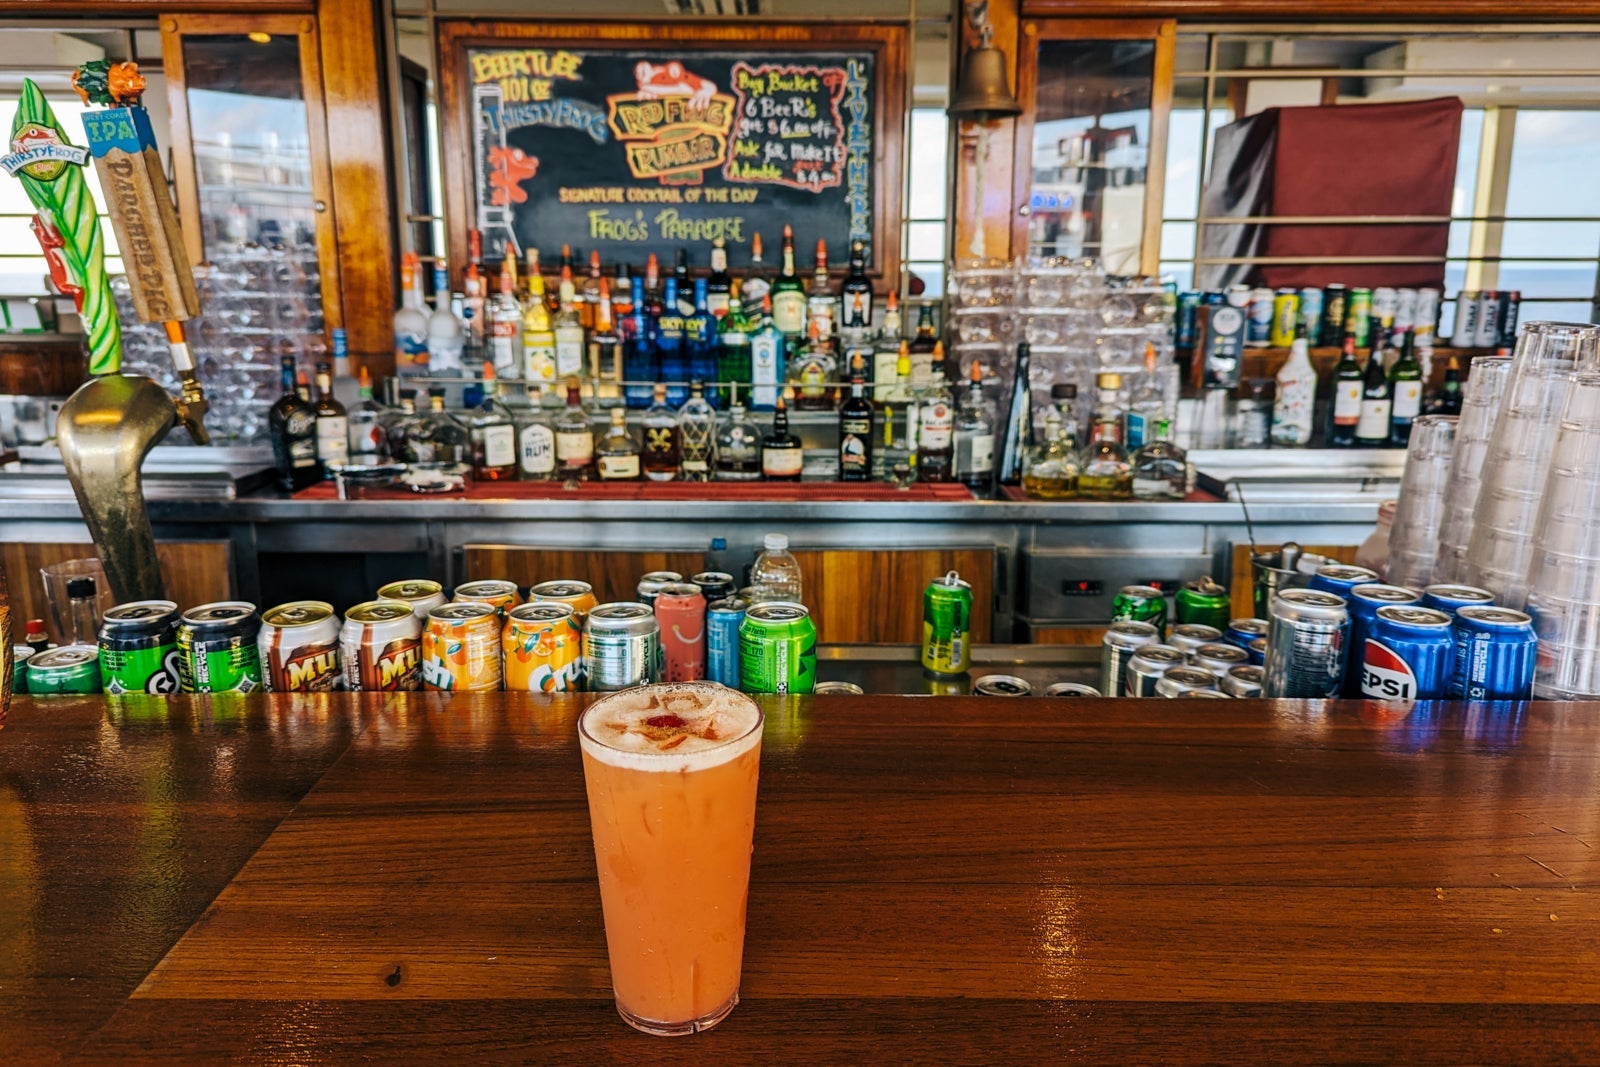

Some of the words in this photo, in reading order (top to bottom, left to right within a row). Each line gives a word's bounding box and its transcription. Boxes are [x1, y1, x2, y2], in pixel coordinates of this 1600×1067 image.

[501, 77, 529, 102] 101
[87, 120, 136, 143] IPA
[559, 187, 625, 203] SIGNATURE
[626, 187, 684, 203] COCKTAIL
[685, 187, 701, 203] OF
[704, 187, 729, 203] THE
[731, 187, 759, 203] DAY
[200, 641, 210, 684] RECYCLE
[780, 640, 788, 683] RECYCLE
[1478, 641, 1489, 684] RECYCLE
